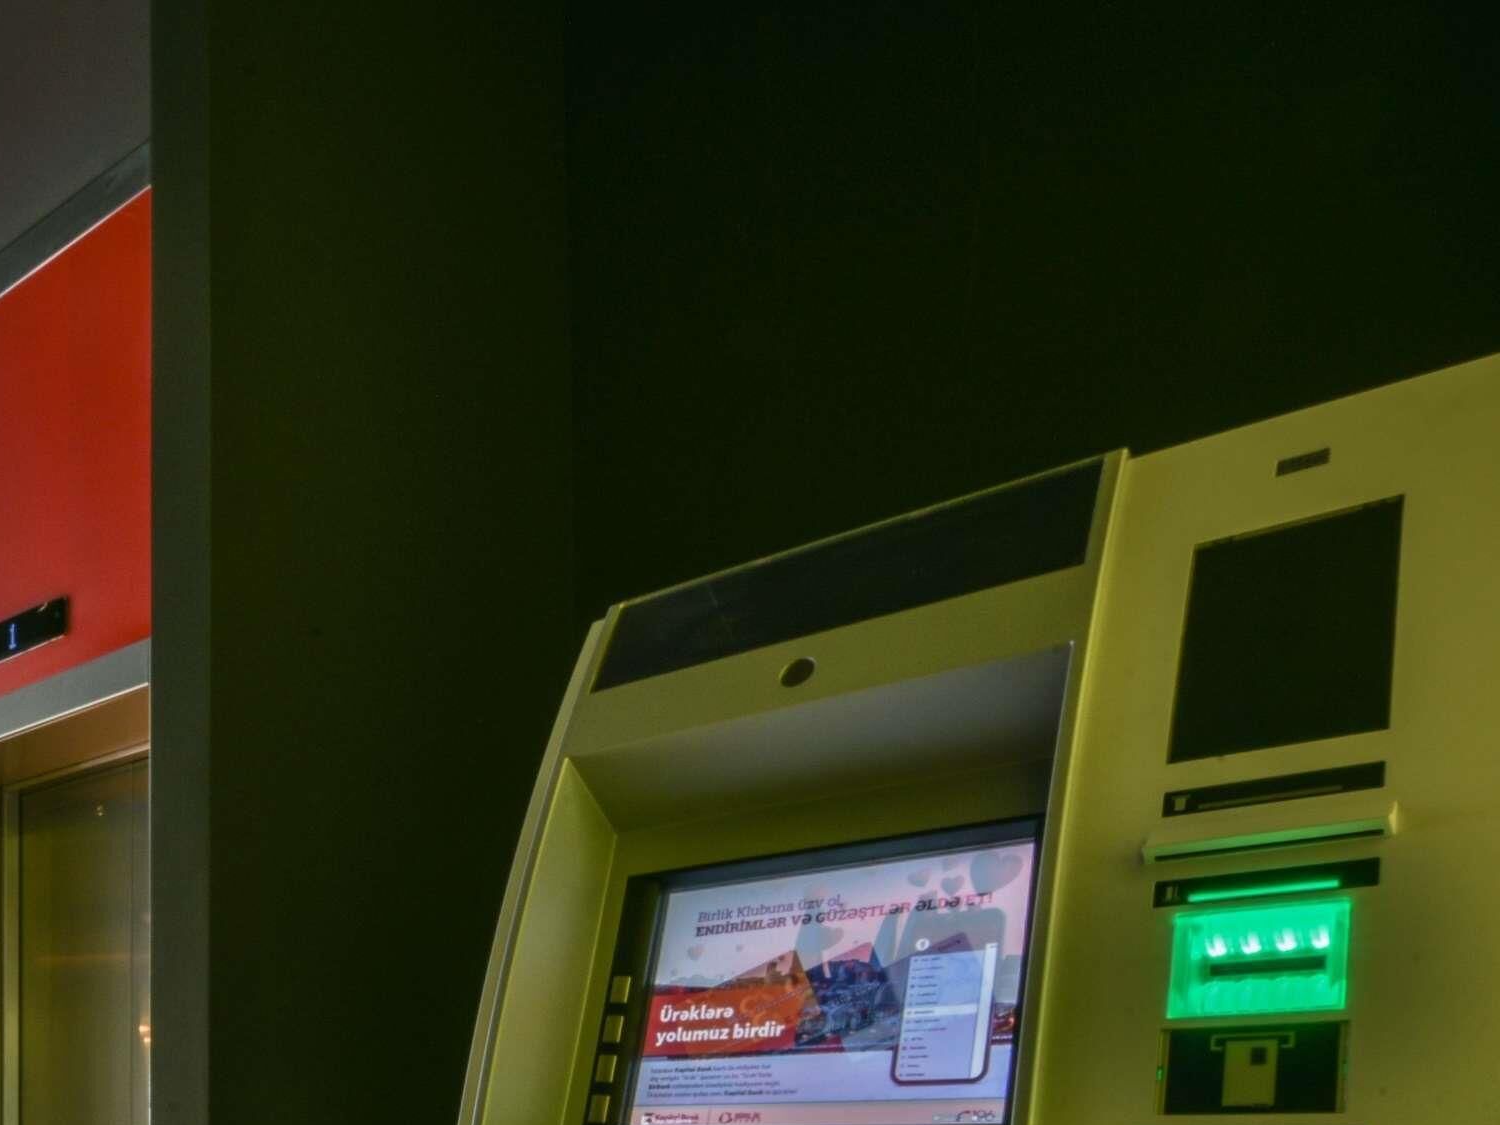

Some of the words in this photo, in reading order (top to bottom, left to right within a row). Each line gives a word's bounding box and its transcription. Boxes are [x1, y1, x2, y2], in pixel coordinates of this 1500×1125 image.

[7, 623, 17, 650] 1
[697, 907, 734, 923] Birlik
[736, 901, 794, 918] Klubuna
[798, 897, 825, 911] üzv
[695, 916, 787, 938] ENDİRİMLƏR
[659, 1003, 735, 1023] Ürəklərə
[655, 1025, 730, 1047] yolumuz
[732, 1019, 786, 1039] birdir
